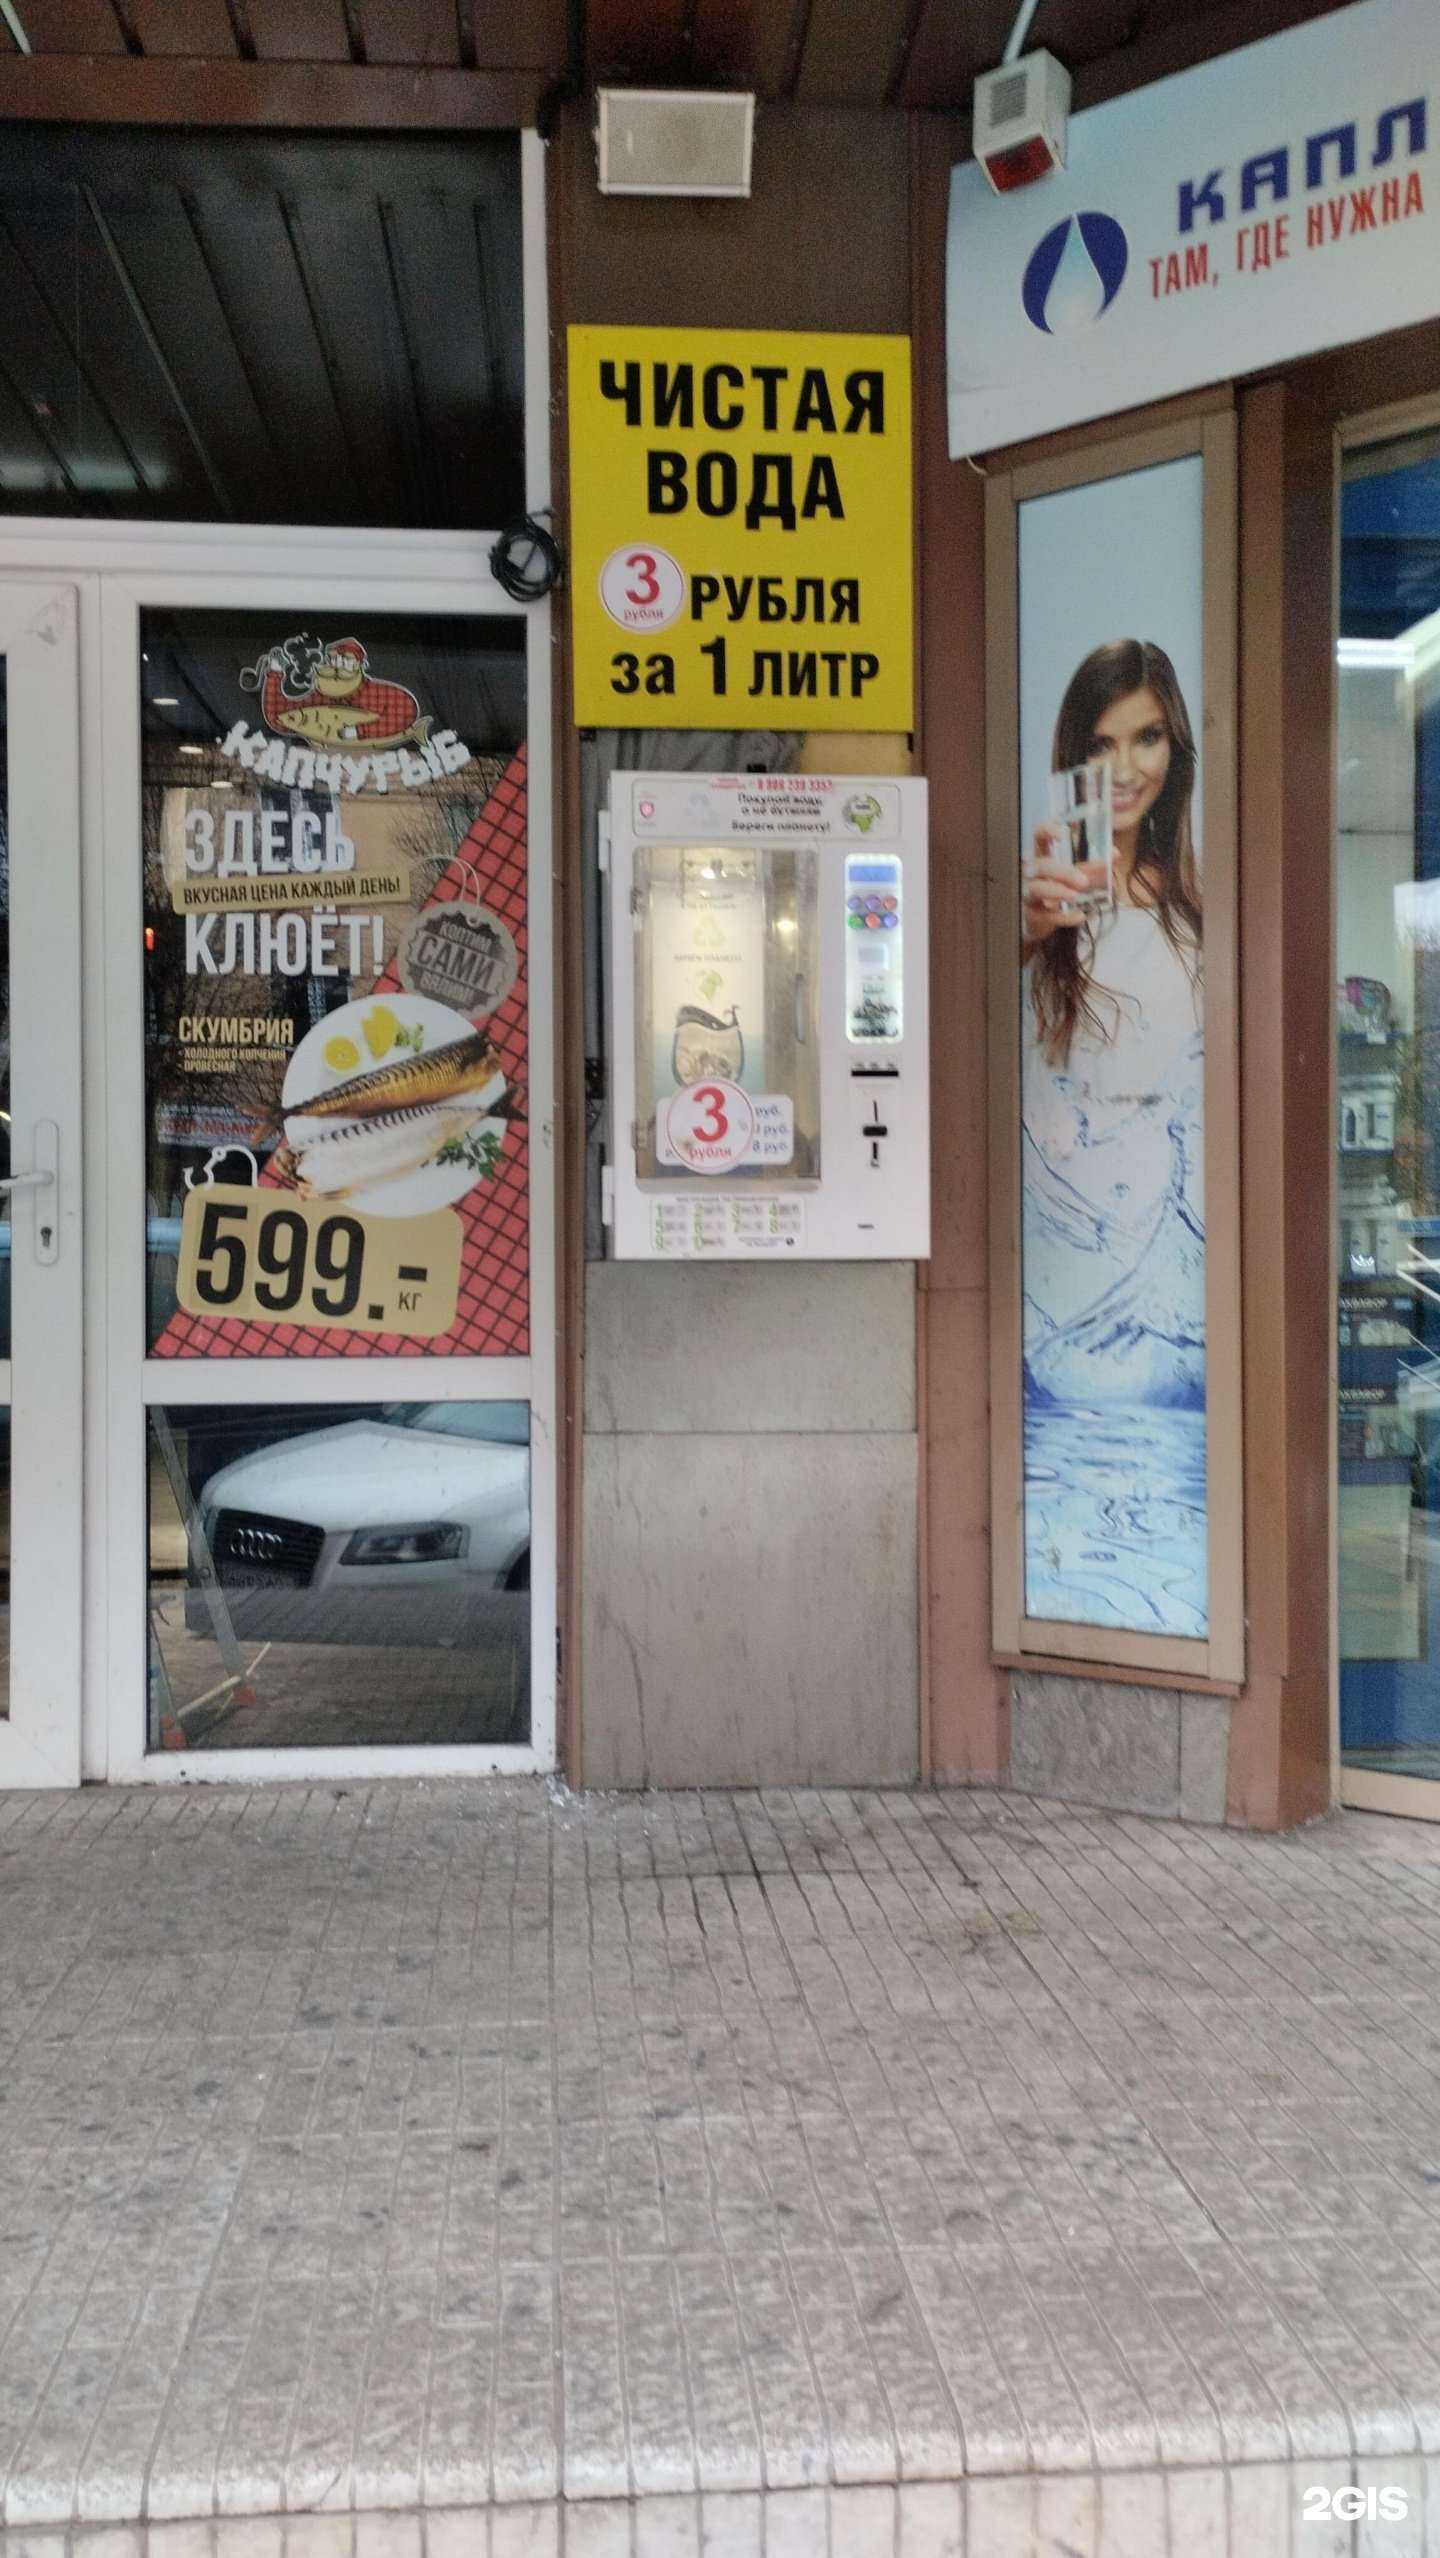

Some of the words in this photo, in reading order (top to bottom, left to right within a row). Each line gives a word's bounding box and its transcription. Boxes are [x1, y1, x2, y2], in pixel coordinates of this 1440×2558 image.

[1149, 243, 1218, 300] ТАМ,
[1237, 215, 1290, 272] ГДЕ
[1306, 170, 1424, 250] НУЖНА
[600, 360, 885, 435] ЧИСТАЯ
[647, 449, 845, 531] ВОДА
[624, 553, 660, 605] 3
[690, 574, 860, 624] РУБЛЯ
[610, 652, 675, 695] за
[700, 636, 727, 695] 1
[748, 650, 880, 698] ЛИТР
[185, 808, 355, 879] ЗДЕСЬ
[183, 884, 247, 905] ВКУСНАЯ
[250, 882, 288, 901] ЦЕНА
[291, 876, 357, 900] КАЖДЫЙ
[359, 875, 400, 898] ДЕНЬ!
[185, 903, 385, 977] КЛЮЁТ!
[417, 935, 496, 990] САМИ
[178, 1016, 294, 1046] СКУМБРИЯ
[184, 1047, 238, 1060] ХОЛОДНОГО
[693, 1086, 729, 1142] 3
